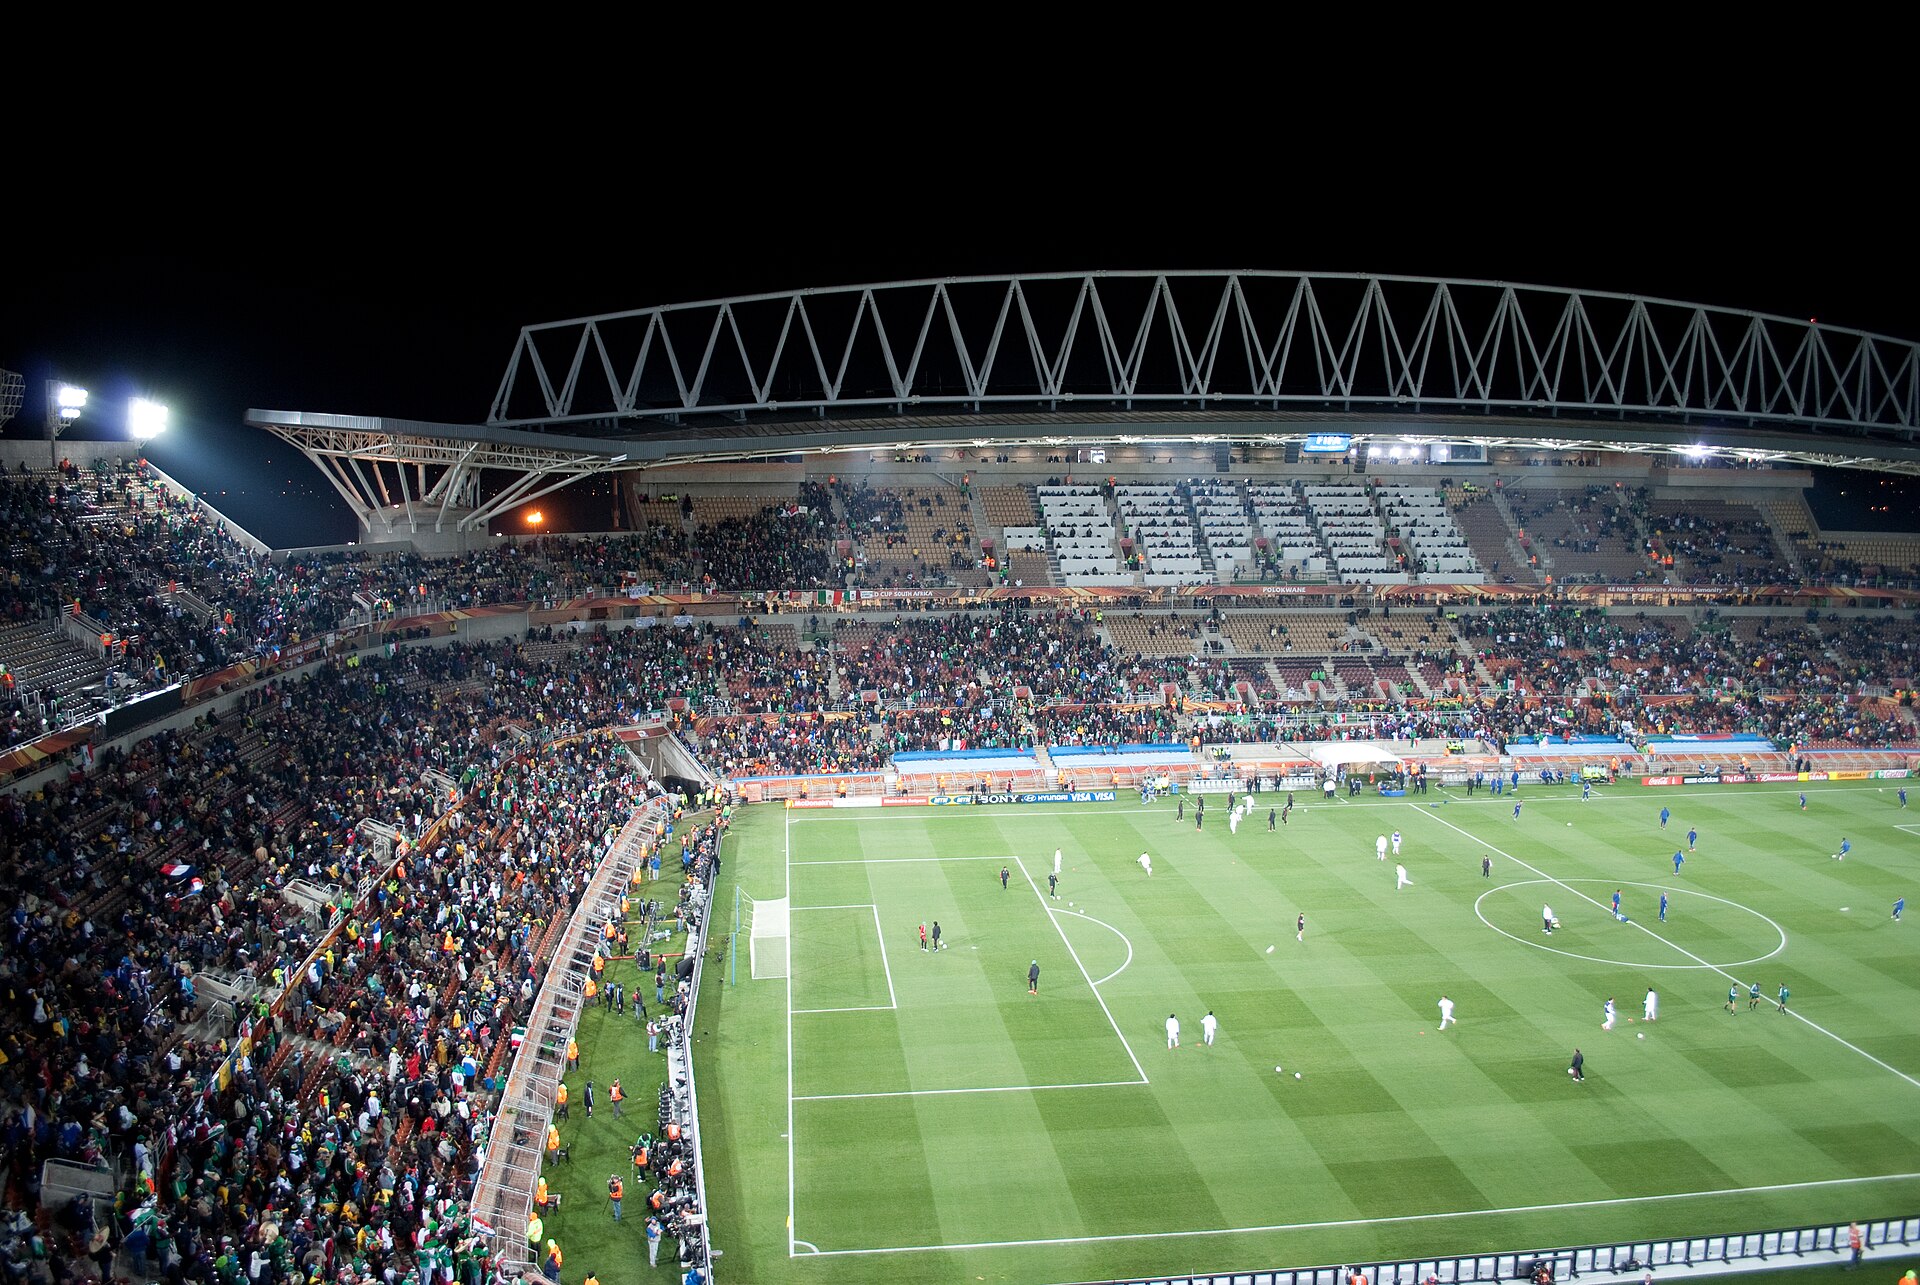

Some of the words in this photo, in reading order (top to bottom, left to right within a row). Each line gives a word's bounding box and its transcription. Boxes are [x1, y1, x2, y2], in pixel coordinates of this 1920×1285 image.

[1760, 773, 1798, 782] Budweiser
[1885, 770, 1907, 778] Castrol
[1723, 775, 1733, 783] Fly
[981, 794, 1018, 804] SONY
[1070, 792, 1091, 802] VISA
[1093, 792, 1115, 801] VISA
[795, 799, 833, 807] McDonald's
